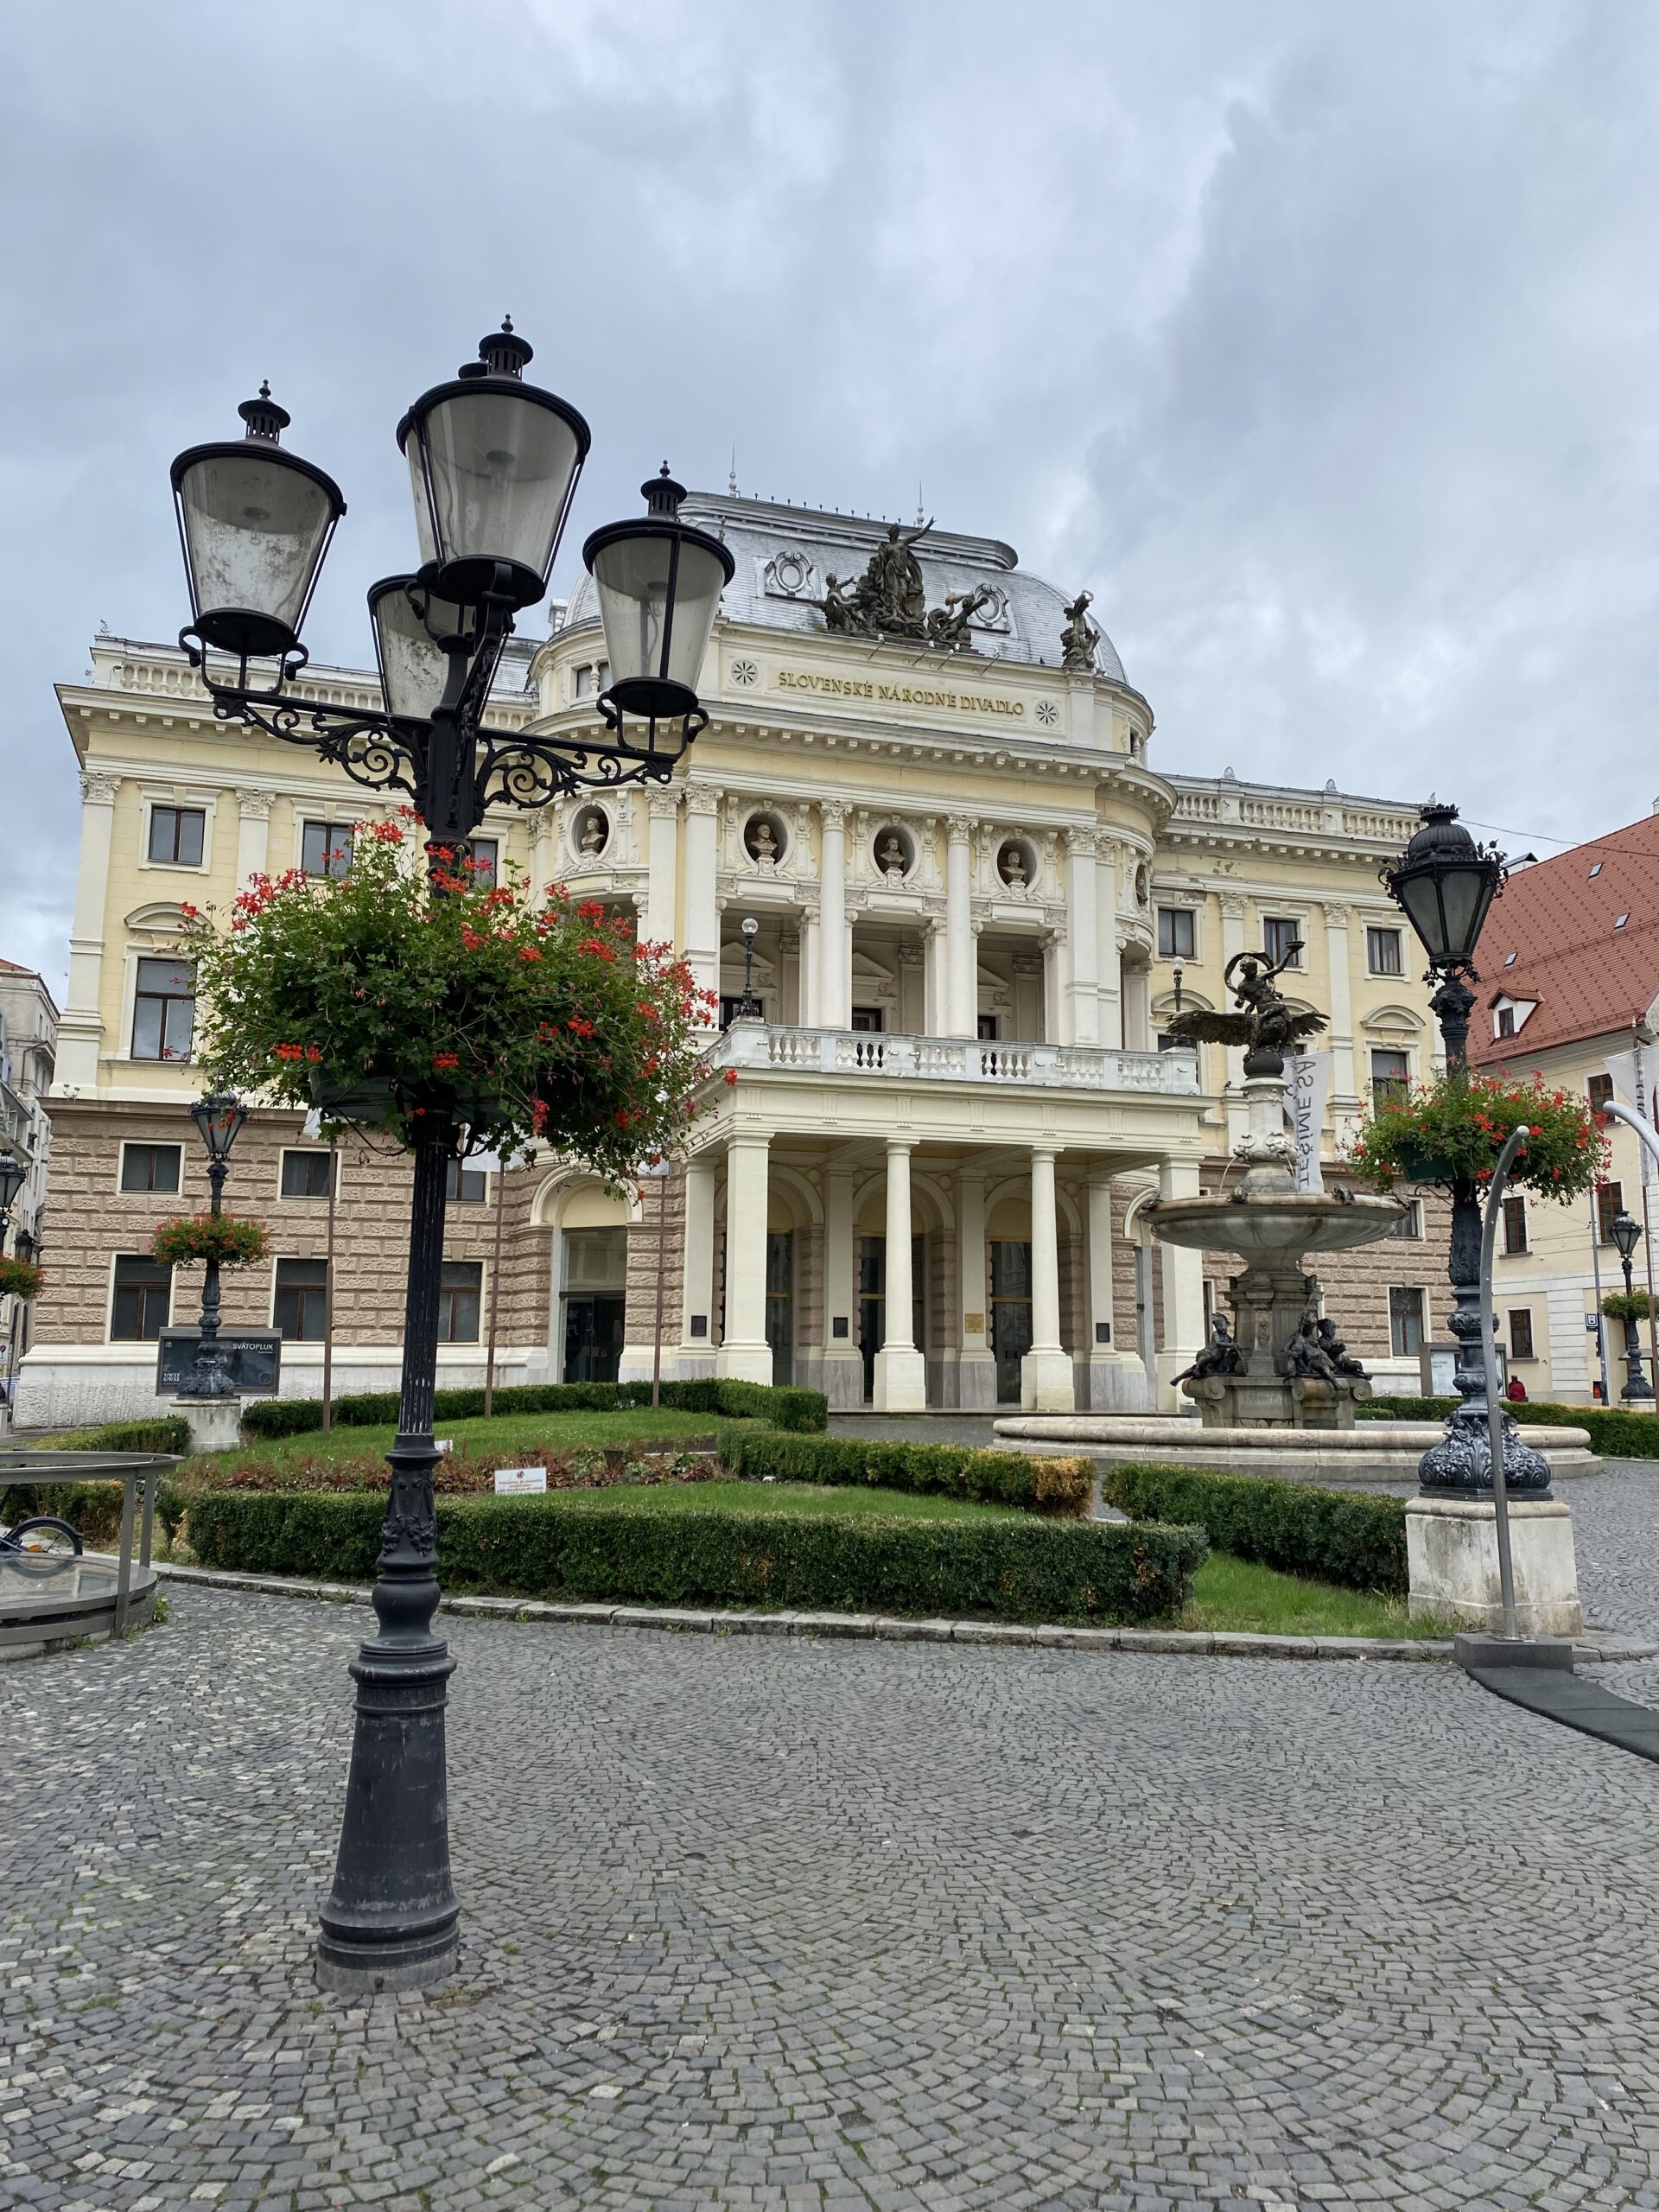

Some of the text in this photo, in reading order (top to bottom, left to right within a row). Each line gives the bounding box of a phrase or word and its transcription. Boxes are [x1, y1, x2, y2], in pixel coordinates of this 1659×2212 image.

[779, 671, 1024, 715] SLOVENSKÉ NÁRODNÉ DIVADLO
